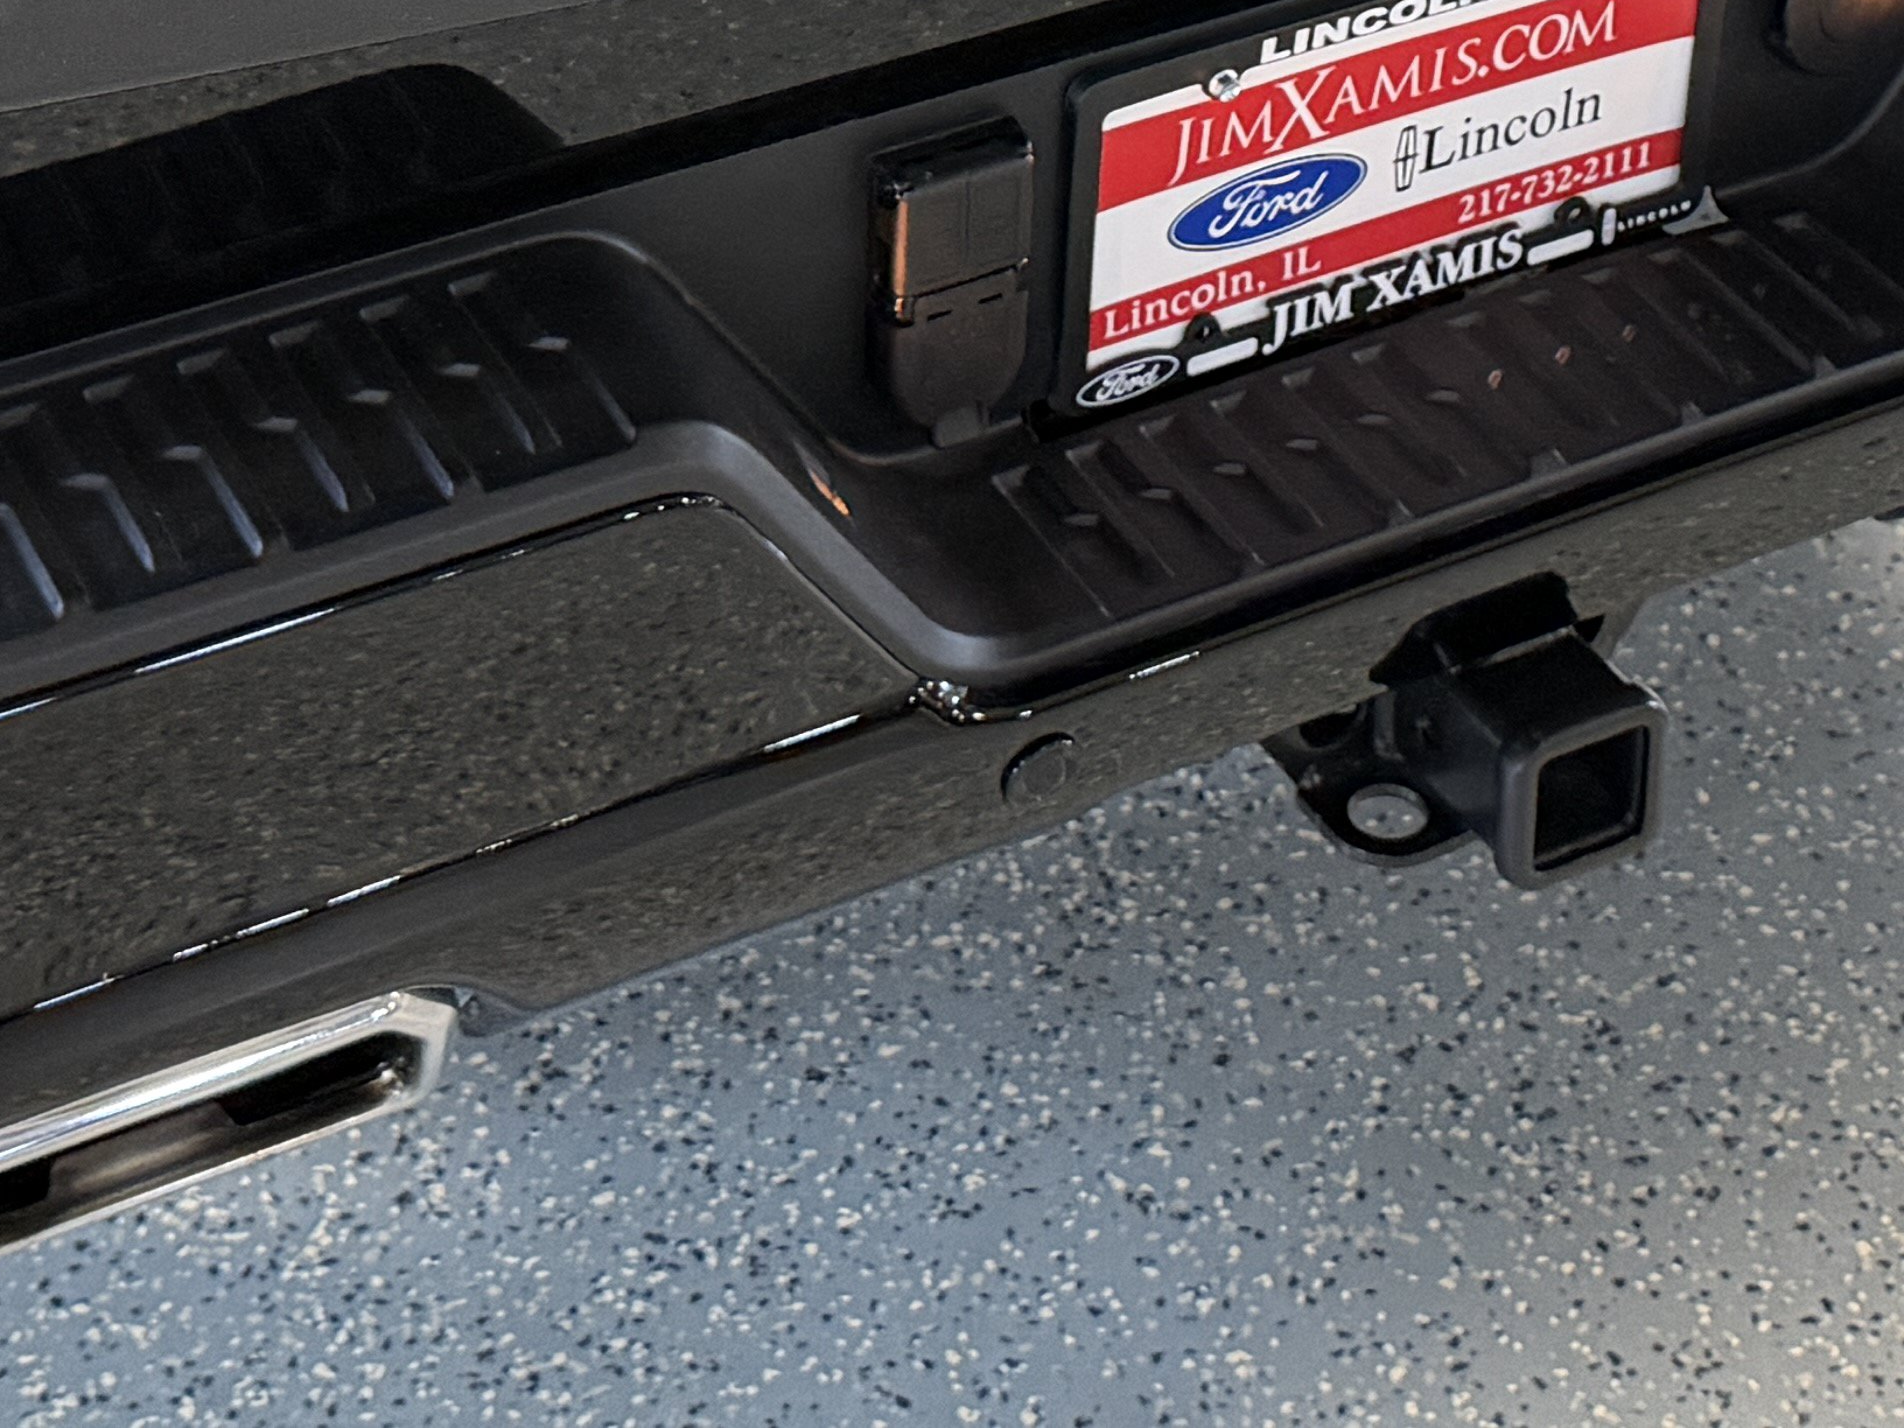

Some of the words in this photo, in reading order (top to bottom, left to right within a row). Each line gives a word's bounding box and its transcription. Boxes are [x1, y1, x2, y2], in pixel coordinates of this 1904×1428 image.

[1167, 0, 1617, 186] JIMXAMIS.COM
[1418, 86, 1603, 173] Lincoln
[1207, 168, 1327, 239] Ford
[1457, 141, 1652, 226] 217-732-2111
[1103, 269, 1266, 340] Lincoln,
[1281, 245, 1322, 281] IL
[1262, 283, 1355, 356] JIM
[1366, 228, 1524, 313] XAMIS
[1095, 361, 1162, 402] Ford
